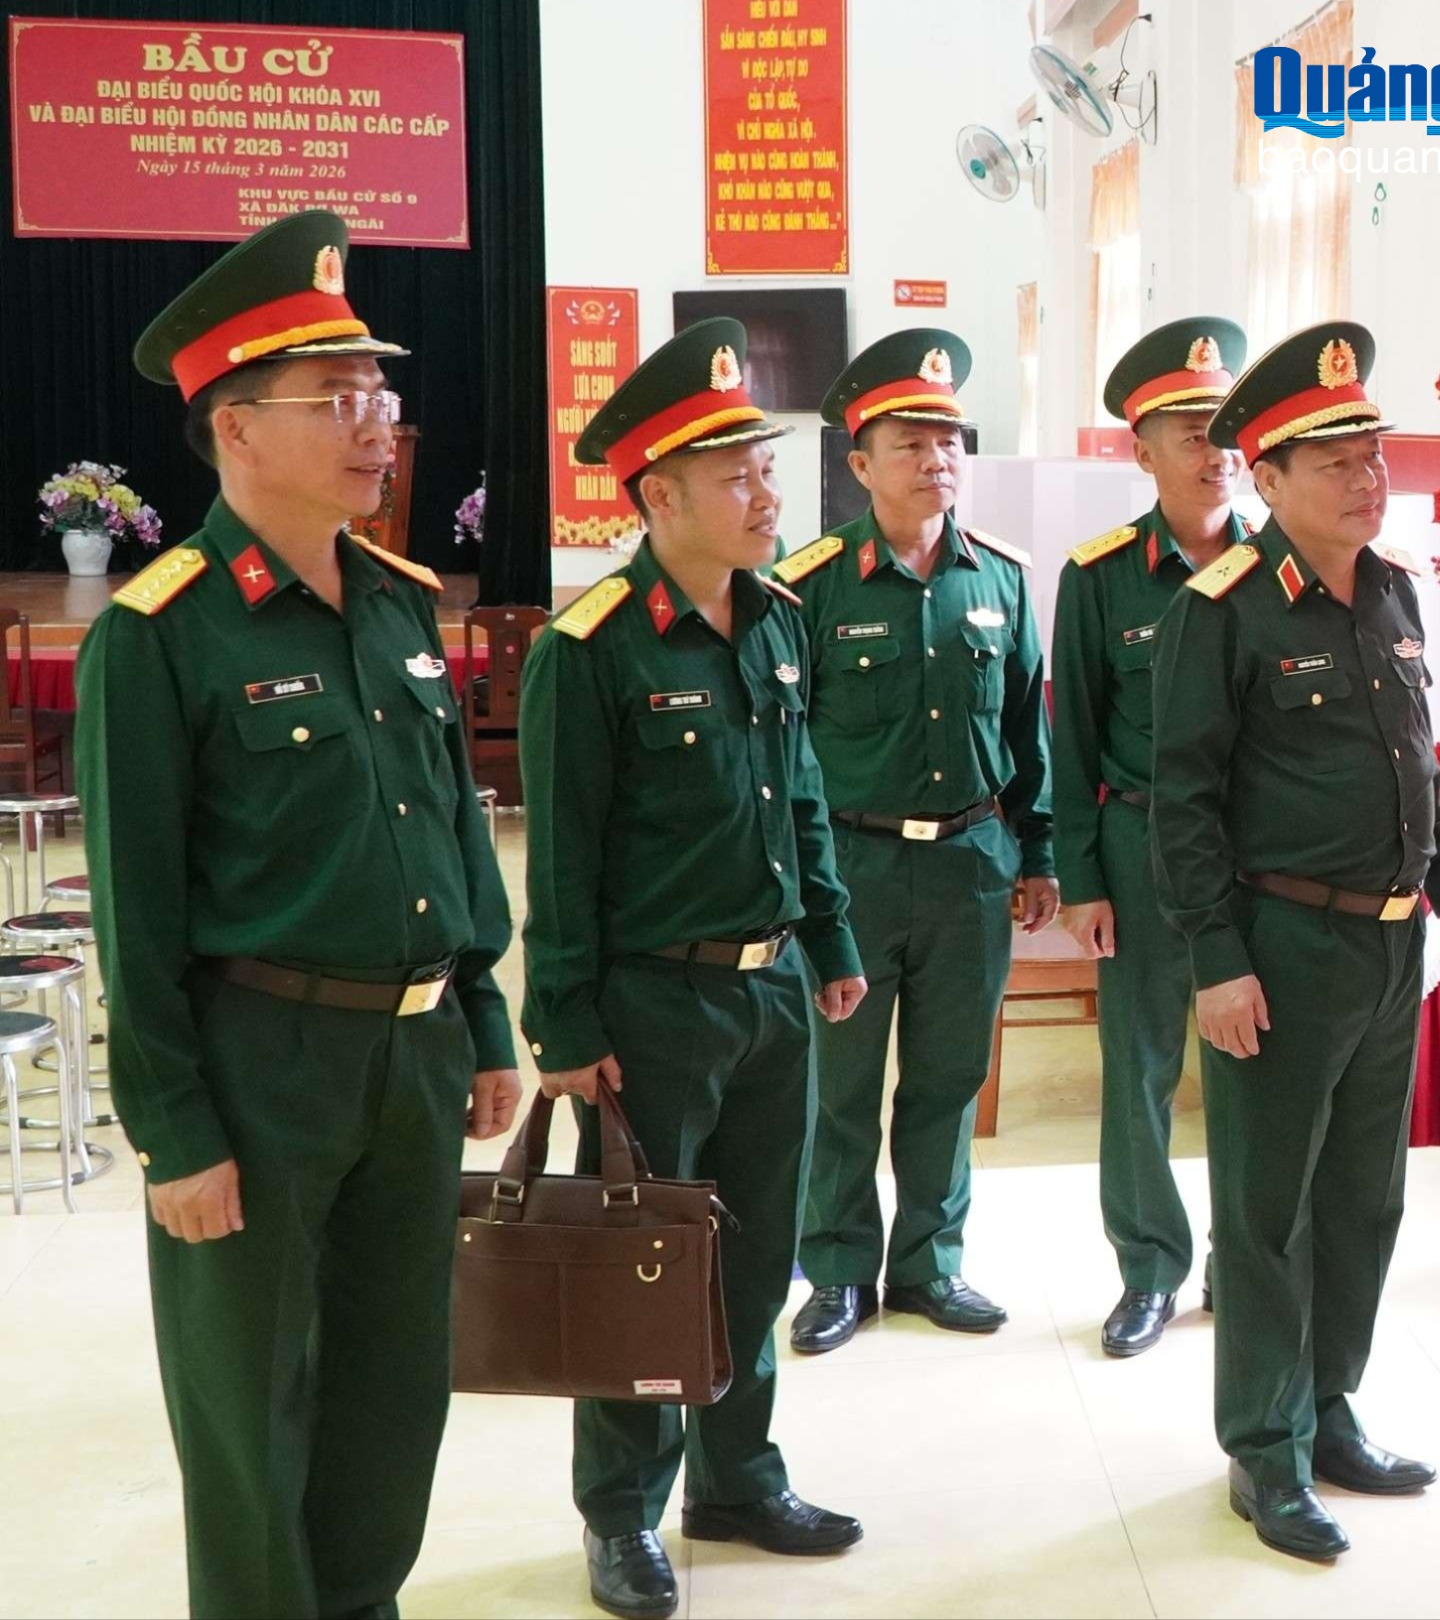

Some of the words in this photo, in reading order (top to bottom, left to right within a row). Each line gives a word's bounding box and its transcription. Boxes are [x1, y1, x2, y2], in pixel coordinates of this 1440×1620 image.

[143, 33, 247, 74] BẦU
[262, 39, 333, 76] CỬ
[97, 80, 131, 101] ĐẠI
[137, 76, 183, 100] BIỂU
[189, 78, 242, 103] QUỐC
[249, 82, 282, 107] HỘI
[289, 85, 343, 106] KHÓA
[349, 89, 380, 107] XVI
[29, 101, 56, 123] VÀ
[60, 105, 94, 127] ĐẠI
[101, 101, 146, 126] BIỂU
[152, 106, 186, 130] HỘI
[192, 105, 247, 128] ĐỒNG
[254, 109, 309, 131] NHÂN
[316, 111, 358, 133] DÂN
[364, 114, 403, 135] CÁC
[410, 113, 450, 136] CẤP
[130, 132, 196, 157] NHIỆM
[202, 134, 228, 155] KỲ
[234, 138, 282, 156] 2026
[303, 140, 349, 159] 2031
[137, 159, 178, 176] Ngày
[182, 161, 201, 174] 15
[205, 161, 250, 179] tháng
[255, 164, 264, 176] 3
[269, 165, 304, 177] năm
[309, 165, 347, 178] 2026
[238, 188, 272, 199] KHU
[277, 189, 309, 201] VỰC
[353, 190, 377, 202] CỬ
[380, 190, 402, 203] SỐ
[408, 194, 417, 204] 9
[570, 336, 593, 367] SÁNG
[594, 333, 617, 368] SUỐT
[574, 371, 590, 404] LỰA
[576, 471, 598, 501] NHÂN
[600, 471, 617, 501] DÂN
